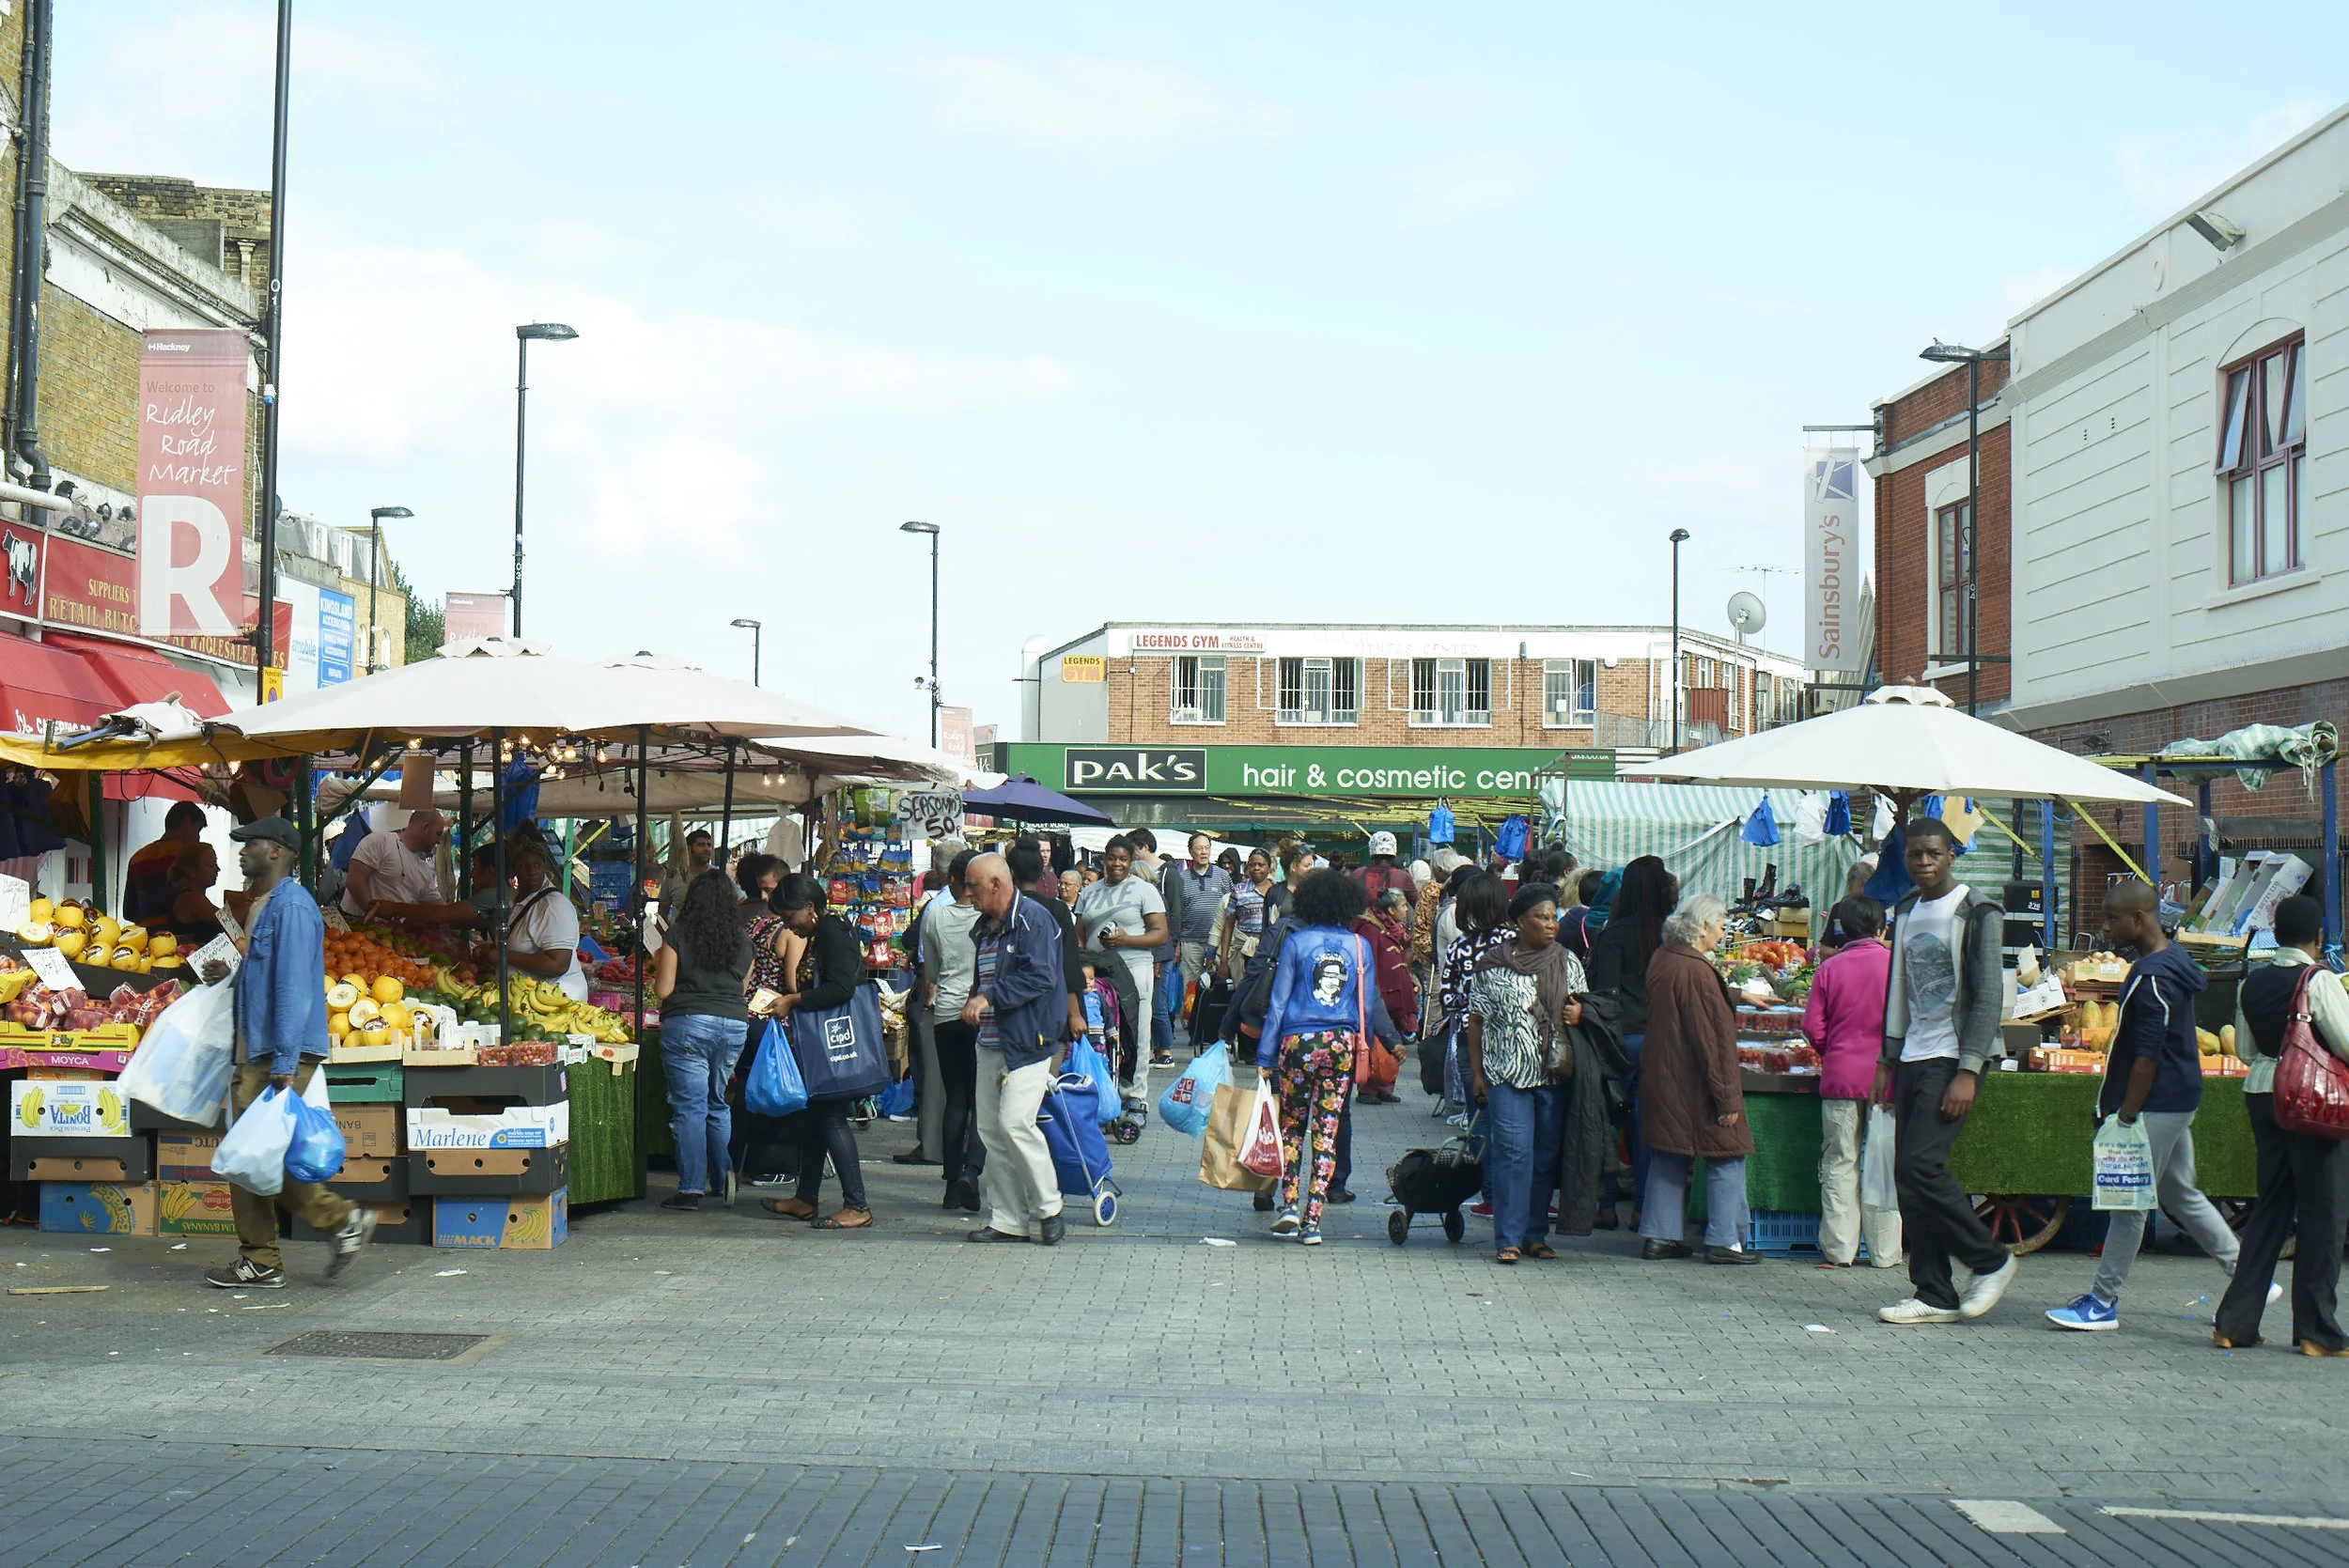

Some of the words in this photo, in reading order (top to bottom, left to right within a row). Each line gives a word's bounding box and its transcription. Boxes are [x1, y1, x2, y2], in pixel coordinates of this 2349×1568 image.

[156, 342, 190, 352] Hackney
[147, 380, 199, 393] Welcome
[203, 381, 215, 393] to
[146, 395, 215, 437] Ridley
[161, 429, 217, 456] Road
[148, 453, 237, 485] Market
[141, 495, 237, 636] R
[88, 579, 130, 604] SUPPLIERS
[1818, 515, 1845, 659] Sainsbury's
[49, 597, 98, 629] RETAIL
[104, 609, 136, 634] BUTC
[320, 597, 352, 620] KINGSLAND
[190, 636, 248, 663] WHOLESALE
[1136, 635, 1188, 648] LEGENDS
[1192, 635, 1220, 648] GYM
[1064, 657, 1100, 665] LEGENDS
[1064, 666, 1100, 681] GYM
[1243, 763, 1295, 787] hair
[1307, 763, 1327, 787] &
[1337, 763, 1466, 789] cosmetic
[830, 1029, 850, 1044] cipd
[51, 1056, 89, 1065] MOYCA
[831, 1051, 858, 1062] cipd.co.uk
[50, 1105, 91, 1125] BONITA
[414, 1128, 487, 1149] Marlene
[2097, 1175, 2119, 1184] Card
[2123, 1175, 2149, 1185] Factory
[181, 1221, 220, 1232] BANANAS
[455, 1234, 496, 1246] MACK
